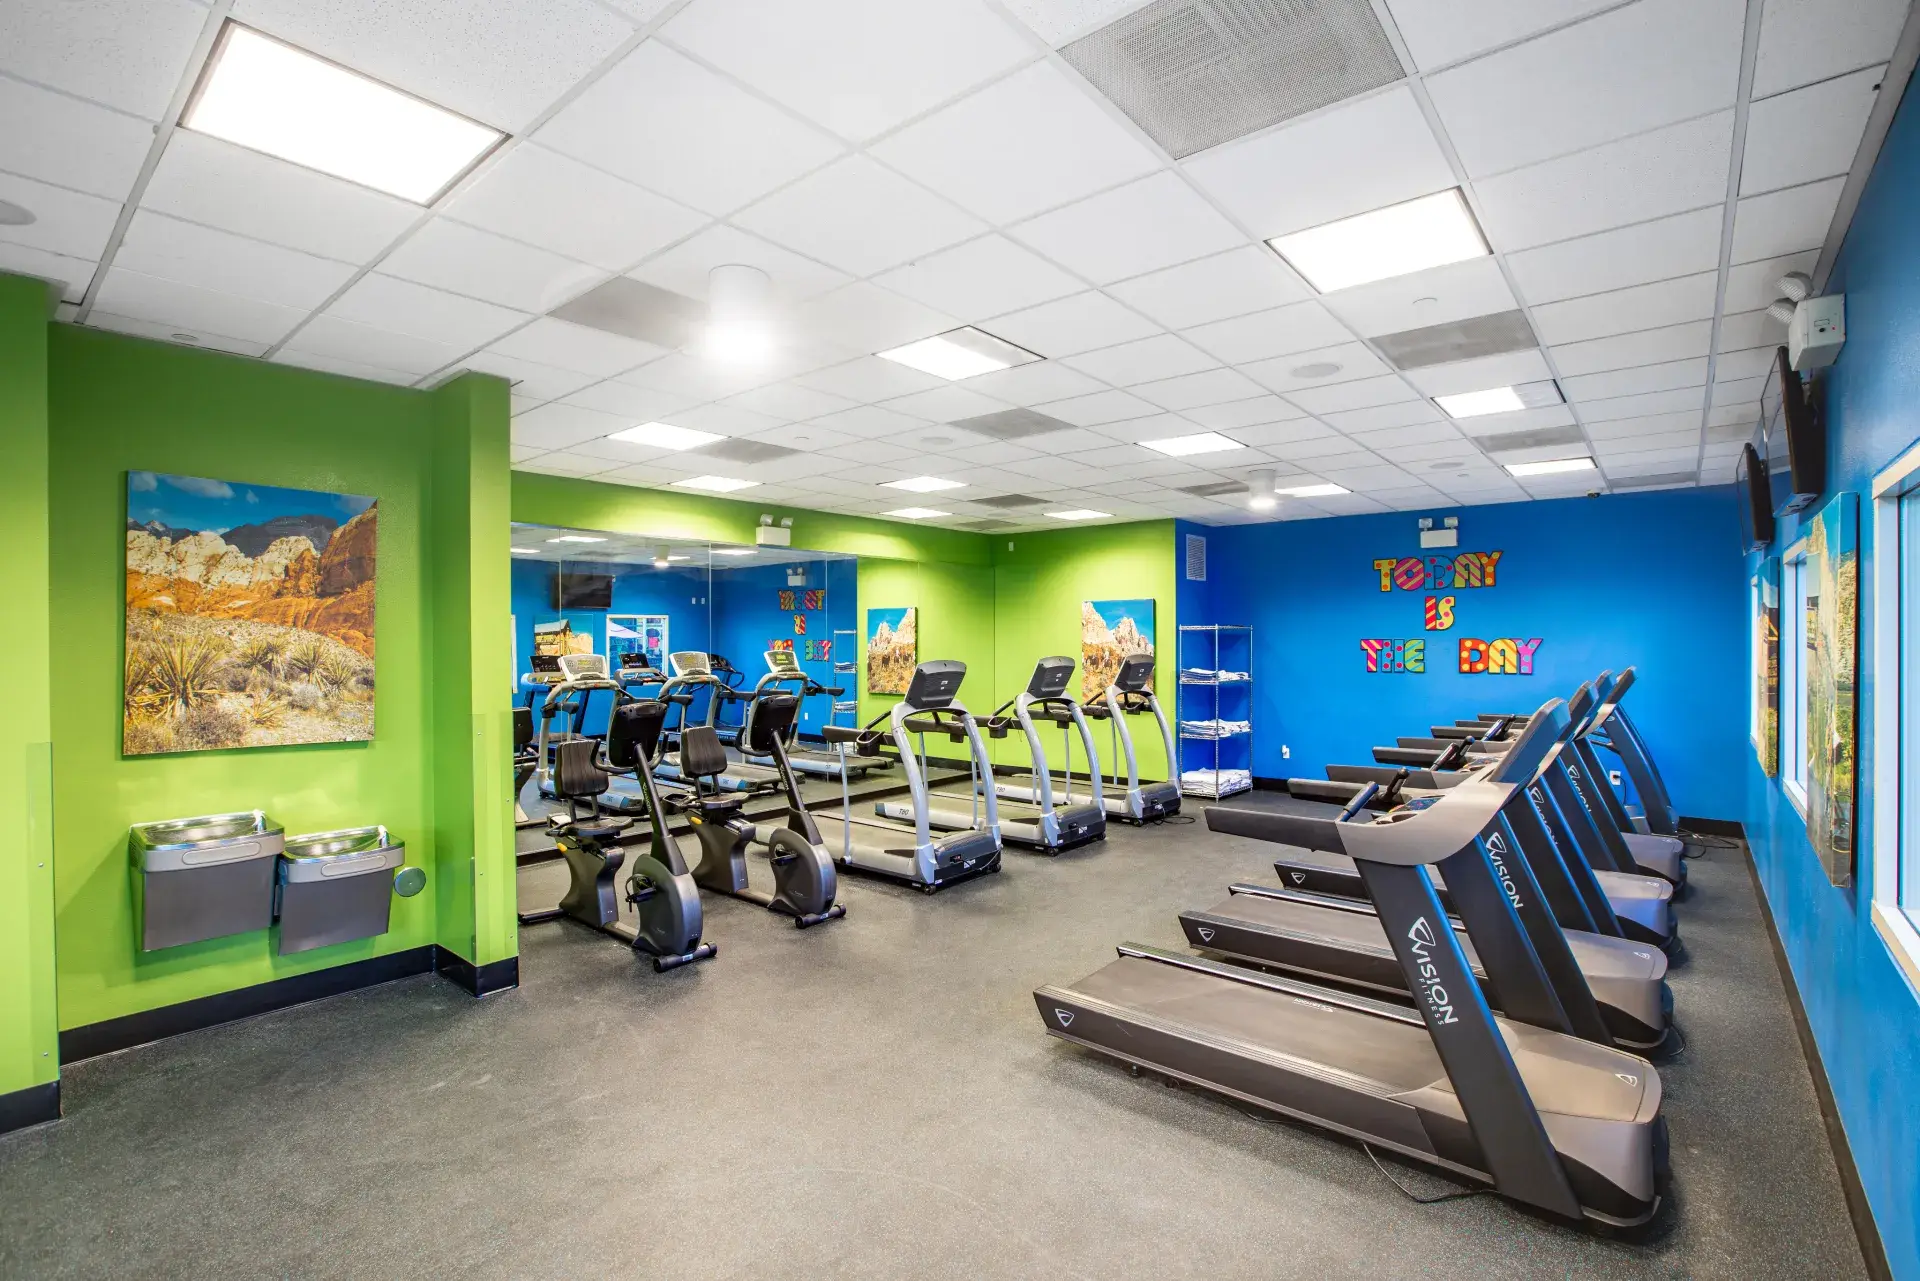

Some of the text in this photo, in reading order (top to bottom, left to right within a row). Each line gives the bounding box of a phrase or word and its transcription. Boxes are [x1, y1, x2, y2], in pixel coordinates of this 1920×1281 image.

[1373, 551, 1503, 592] TODAY
[1425, 596, 1456, 631] IS
[1360, 637, 1543, 674] THE DAY
[1489, 850, 1524, 908] VISION
[1411, 942, 1459, 1024] VISION
[1419, 978, 1445, 1025] FITNESS
